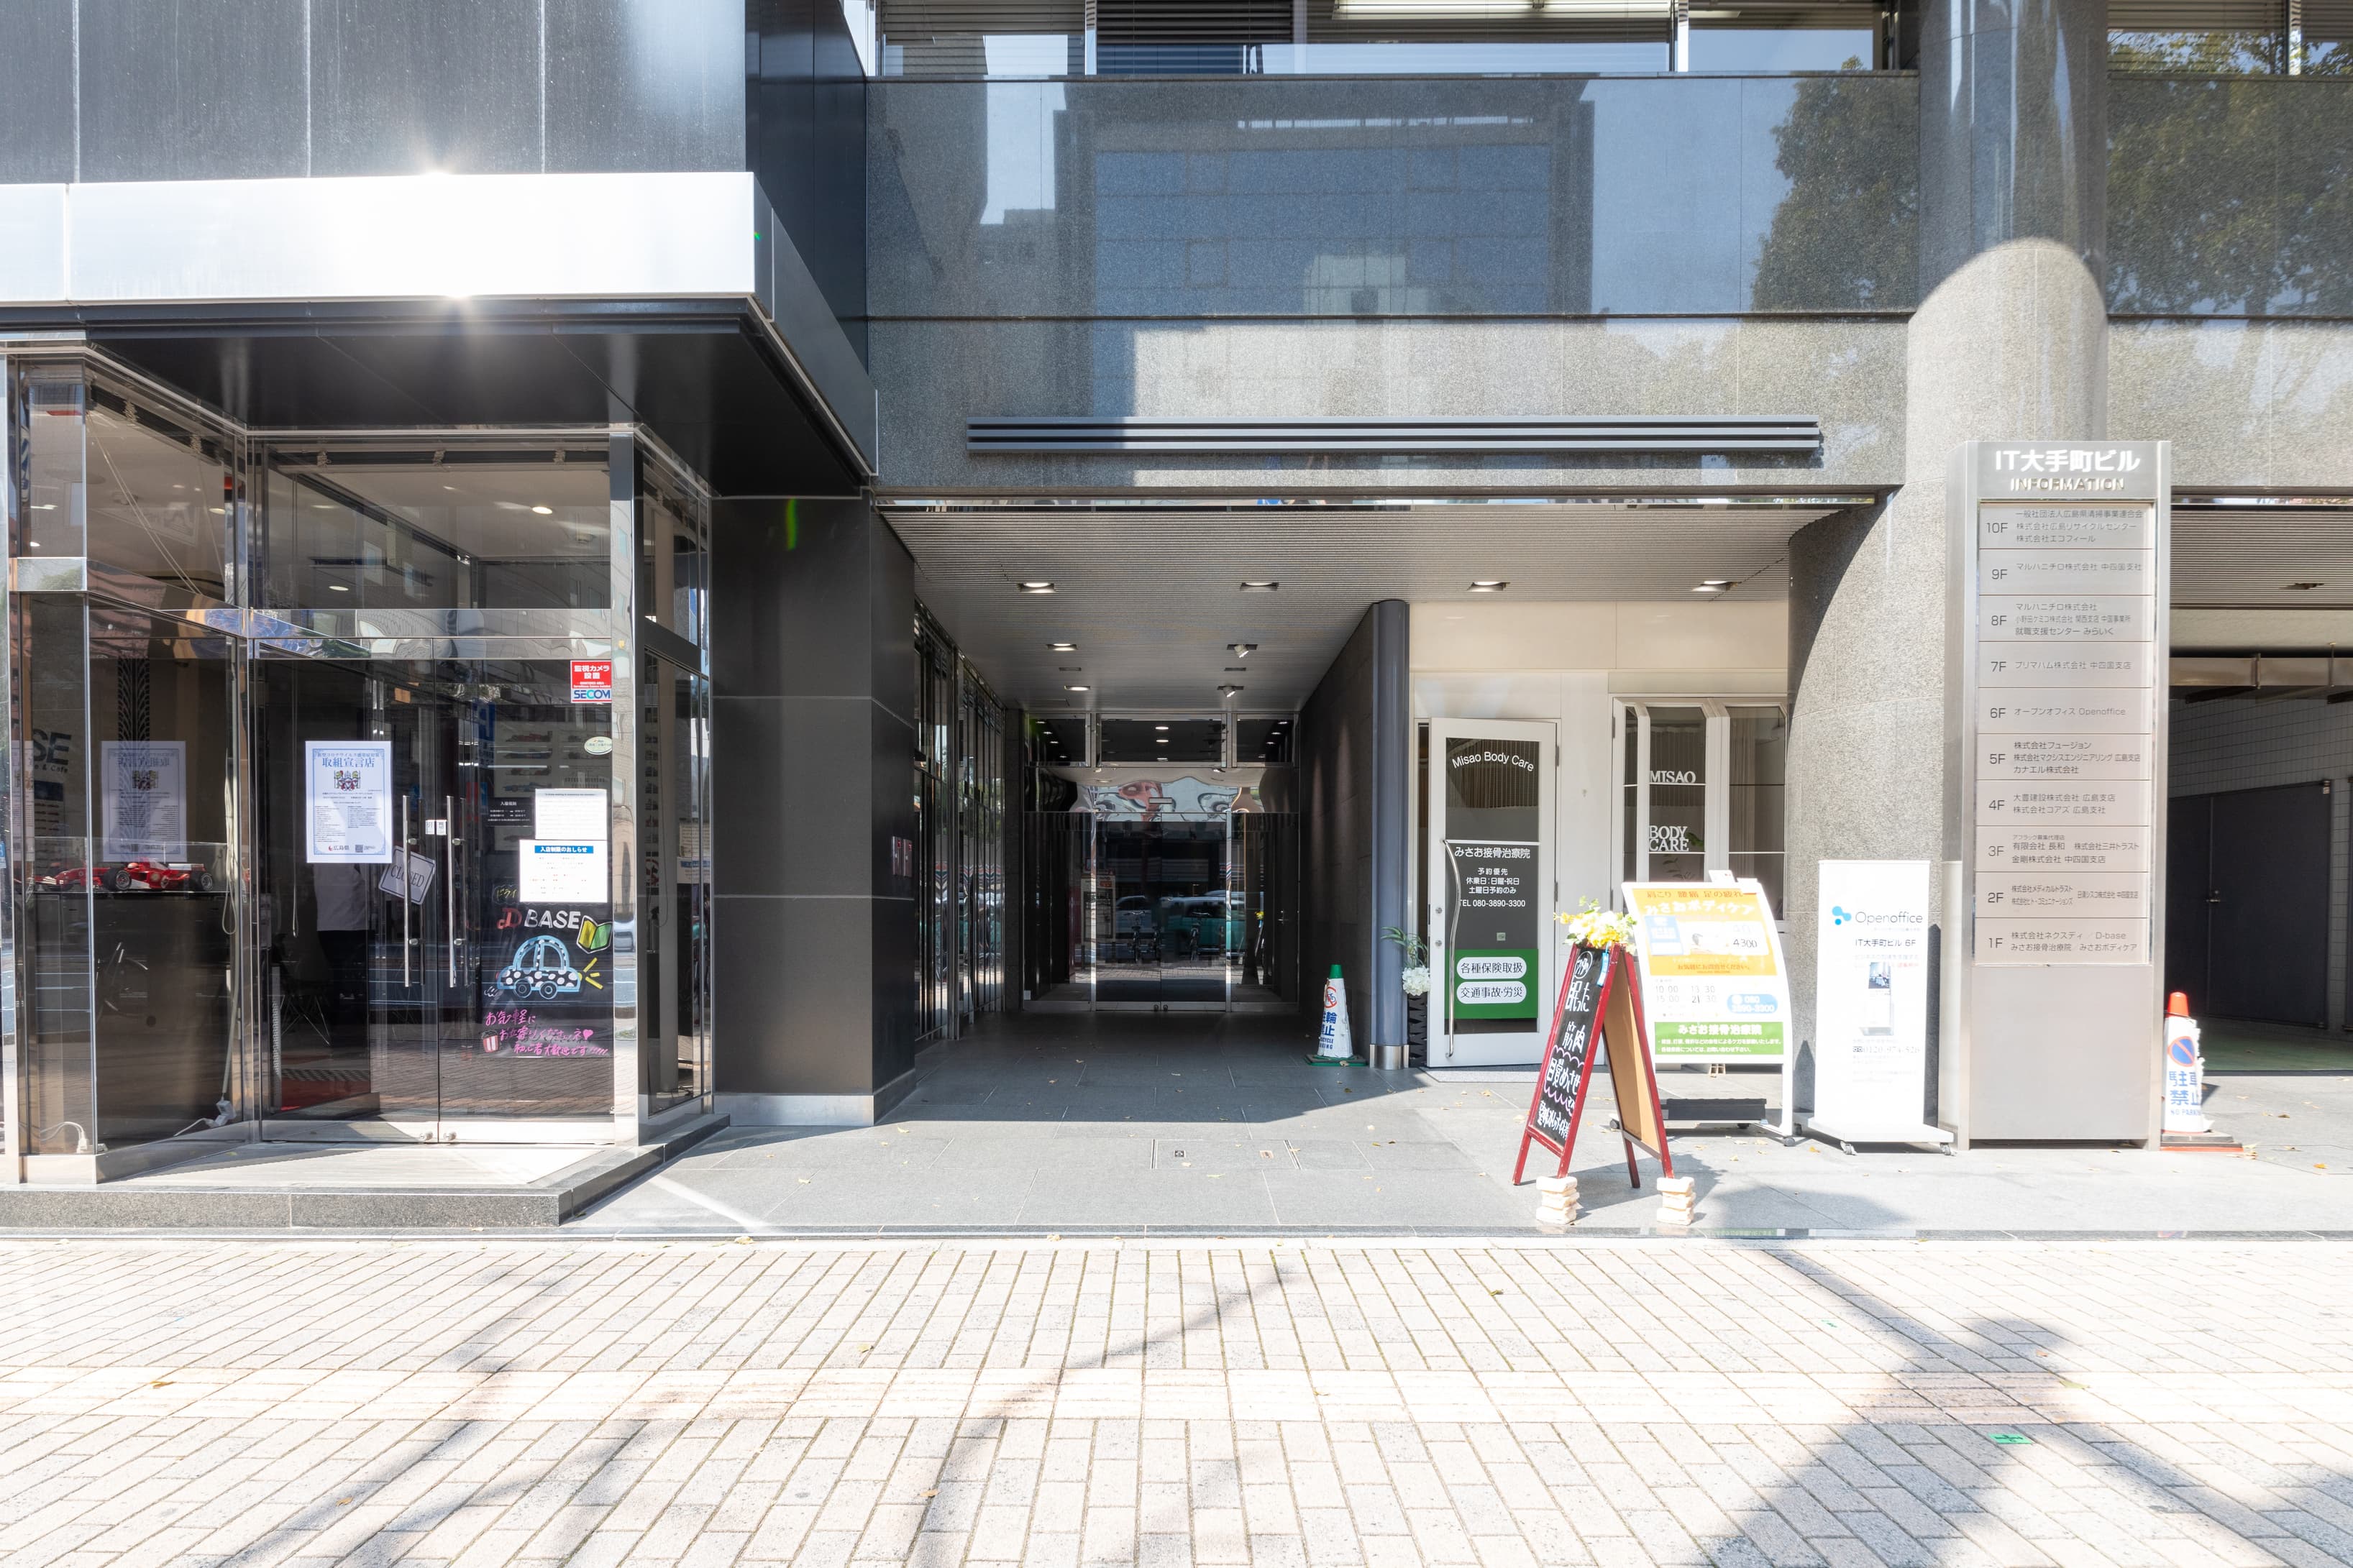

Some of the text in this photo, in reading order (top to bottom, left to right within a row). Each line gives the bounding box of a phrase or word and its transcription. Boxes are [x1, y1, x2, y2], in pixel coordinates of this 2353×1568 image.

[1996, 449, 2141, 472] IT大手町ビル
[2010, 477, 2125, 491] INFORMATION
[1986, 523, 2009, 533] 10F
[1991, 569, 2009, 580] 9F
[2015, 602, 2098, 611] マルハニチロ株式会社
[1991, 615, 2007, 626] 8F
[2015, 627, 2114, 636] 就職支援センター みらいく
[1991, 661, 2007, 672] 7F
[2015, 661, 2087, 670] プリマハム株式会社
[573, 689, 611, 699] SECOM
[1990, 707, 2006, 719] 6F
[2014, 707, 2126, 717] オープンオフィス Openoffice
[2014, 741, 2092, 750] 株式会社フュージョン
[322, 757, 375, 768] 取組宣言店
[1451, 751, 1534, 771] Misao Body Care
[1989, 753, 2006, 764] 5F
[2013, 766, 2080, 774] カナエル株式会社
[1650, 771, 1696, 783] MISAO
[1988, 799, 2006, 811] 4F
[1649, 825, 1688, 839] BODY
[1649, 838, 1689, 852] CARE
[1988, 845, 2004, 856] 3F
[2013, 842, 2046, 851] 有限会社
[1454, 846, 1531, 859] みさお接骨治療院
[2064, 855, 2106, 863] 中四国支店
[390, 864, 424, 887] CLSED
[1987, 892, 2004, 903] 2F
[1645, 900, 1755, 915] みさおボディケア
[524, 909, 581, 930] BASE
[1855, 911, 1923, 926] Openoffice
[1732, 938, 1758, 948] 4300
[1988, 937, 2004, 948] 1F
[2010, 943, 2072, 952] みさお接骨治療院
[1461, 962, 1523, 974] 各種保険取扱
[485, 1009, 536, 1026] お気軽に
[1678, 1024, 1763, 1035] みさお接骨治療院
[1562, 1021, 1586, 1054] 筋肉
